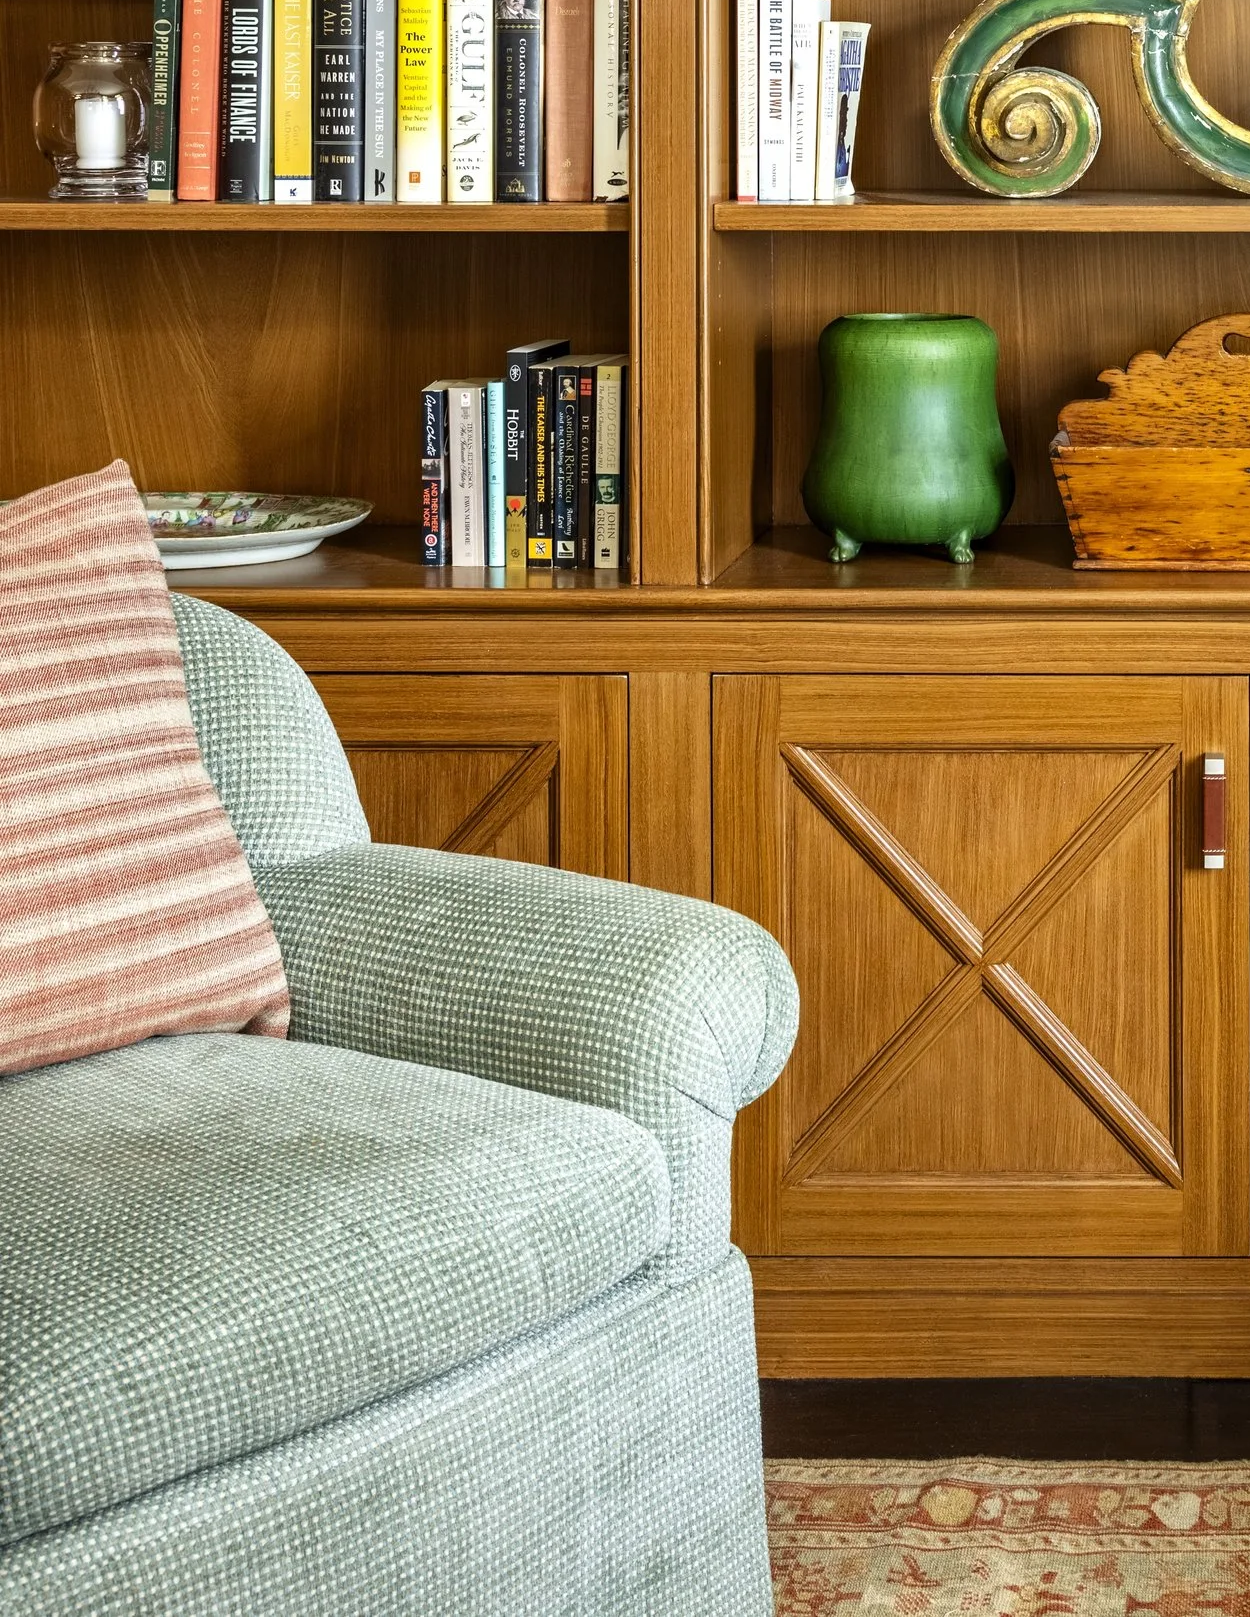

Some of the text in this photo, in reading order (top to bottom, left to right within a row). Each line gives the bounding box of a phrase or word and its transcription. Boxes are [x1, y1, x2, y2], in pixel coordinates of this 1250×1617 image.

[285, 14, 299, 45] LAST
[323, 6, 335, 36] ALL
[405, 32, 426, 41] The
[400, 45, 432, 55] Power
[770, 18, 782, 56] BATTLE
[325, 55, 350, 65] EARL
[405, 58, 426, 67] Law
[461, 12, 485, 102] GULF
[770, 61, 782, 74] OF
[229, 8, 259, 143] LORDS OF FINANCE
[285, 47, 299, 101] KAISER
[320, 72, 355, 83] WARREN
[340, 92, 354, 100] THE
[518, 38, 527, 167] COLONEL ROOSEVELT
[769, 78, 782, 120] MIDWAY
[320, 108, 355, 117] NATION
[319, 125, 355, 135] HE MADE
[425, 394, 436, 456] Agatha Christie
[507, 409, 519, 460] HOBBIT
[537, 396, 545, 503] THE KAISER AND HIS TIMES
[581, 416, 589, 484] DE GAULLE
[466, 451, 474, 490] JEFFERSON
[596, 509, 605, 541] GRIGG
[607, 512, 615, 538] JOHN
